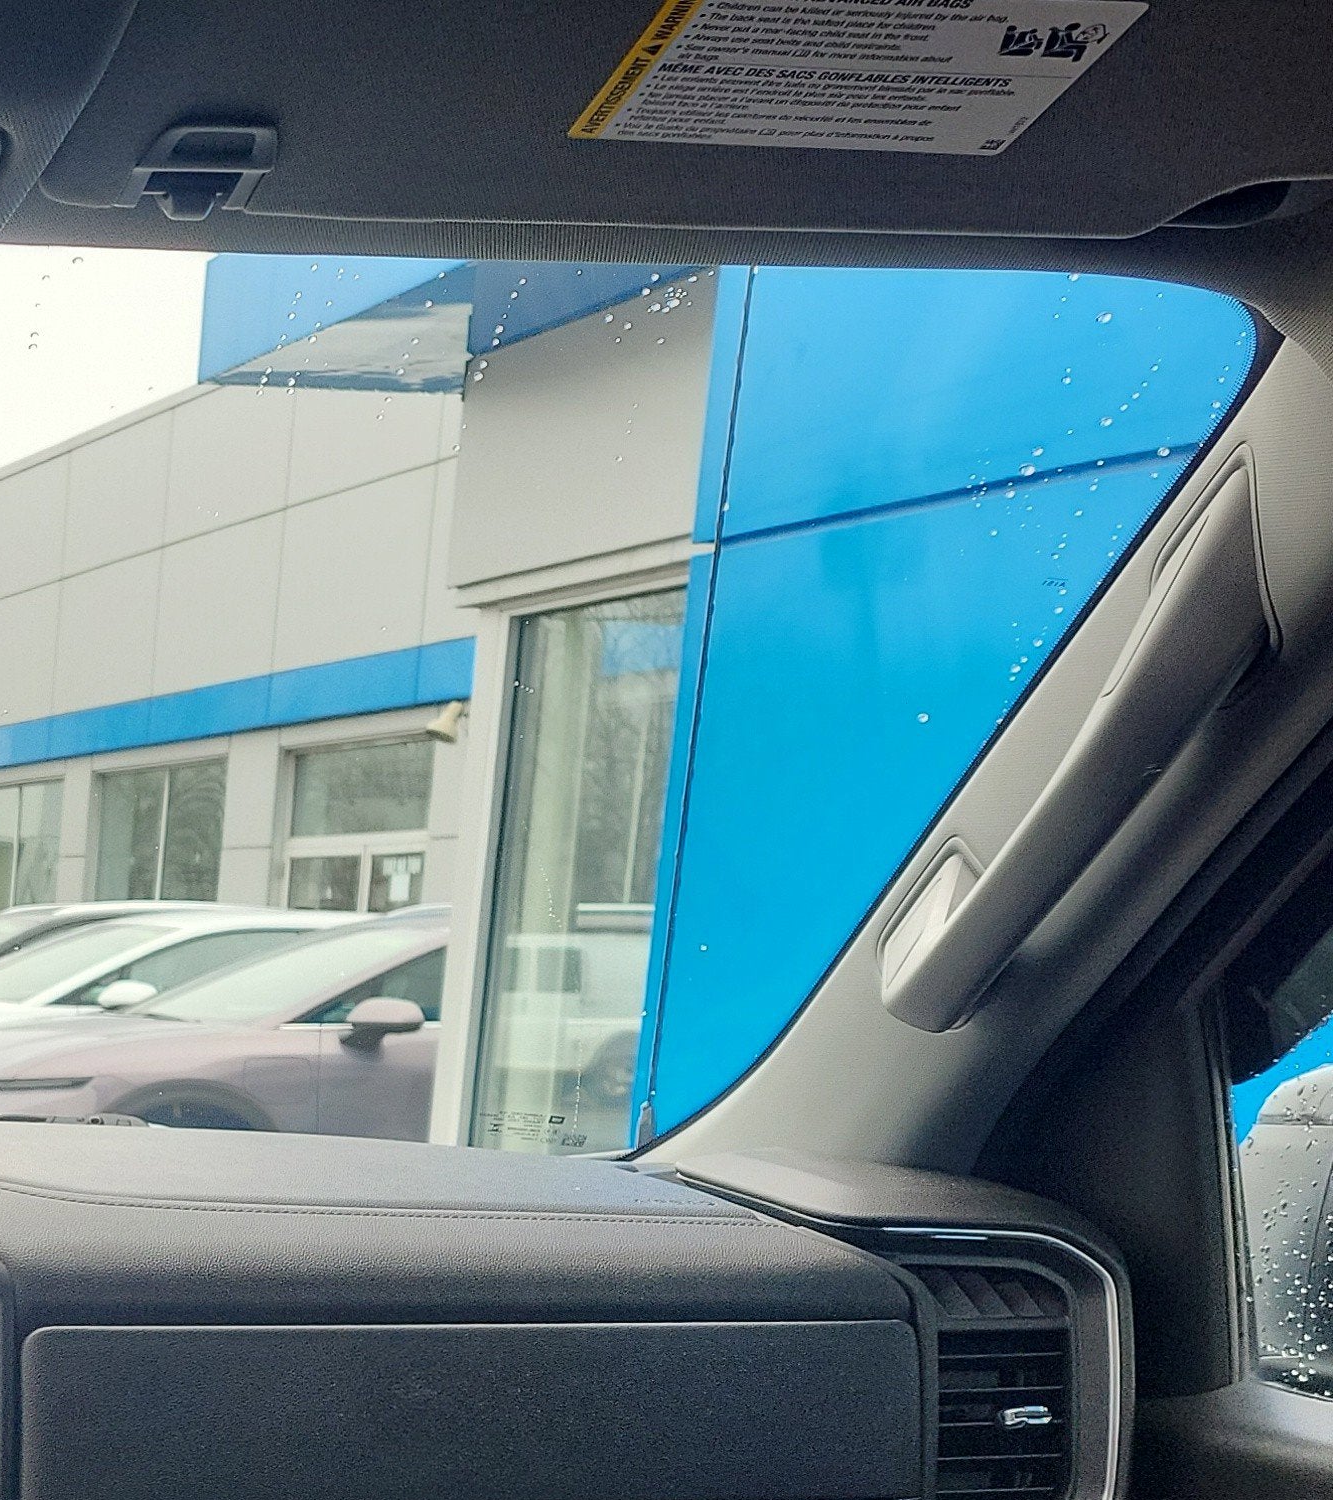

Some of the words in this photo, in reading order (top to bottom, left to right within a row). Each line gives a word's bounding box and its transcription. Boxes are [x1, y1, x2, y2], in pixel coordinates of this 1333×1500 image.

[707, 65, 744, 77] AVEC
[745, 67, 773, 78] DES
[775, 69, 816, 81] SACS
[818, 71, 910, 84] GONFLABLES
[911, 75, 1012, 88] INTELLIGENTS
